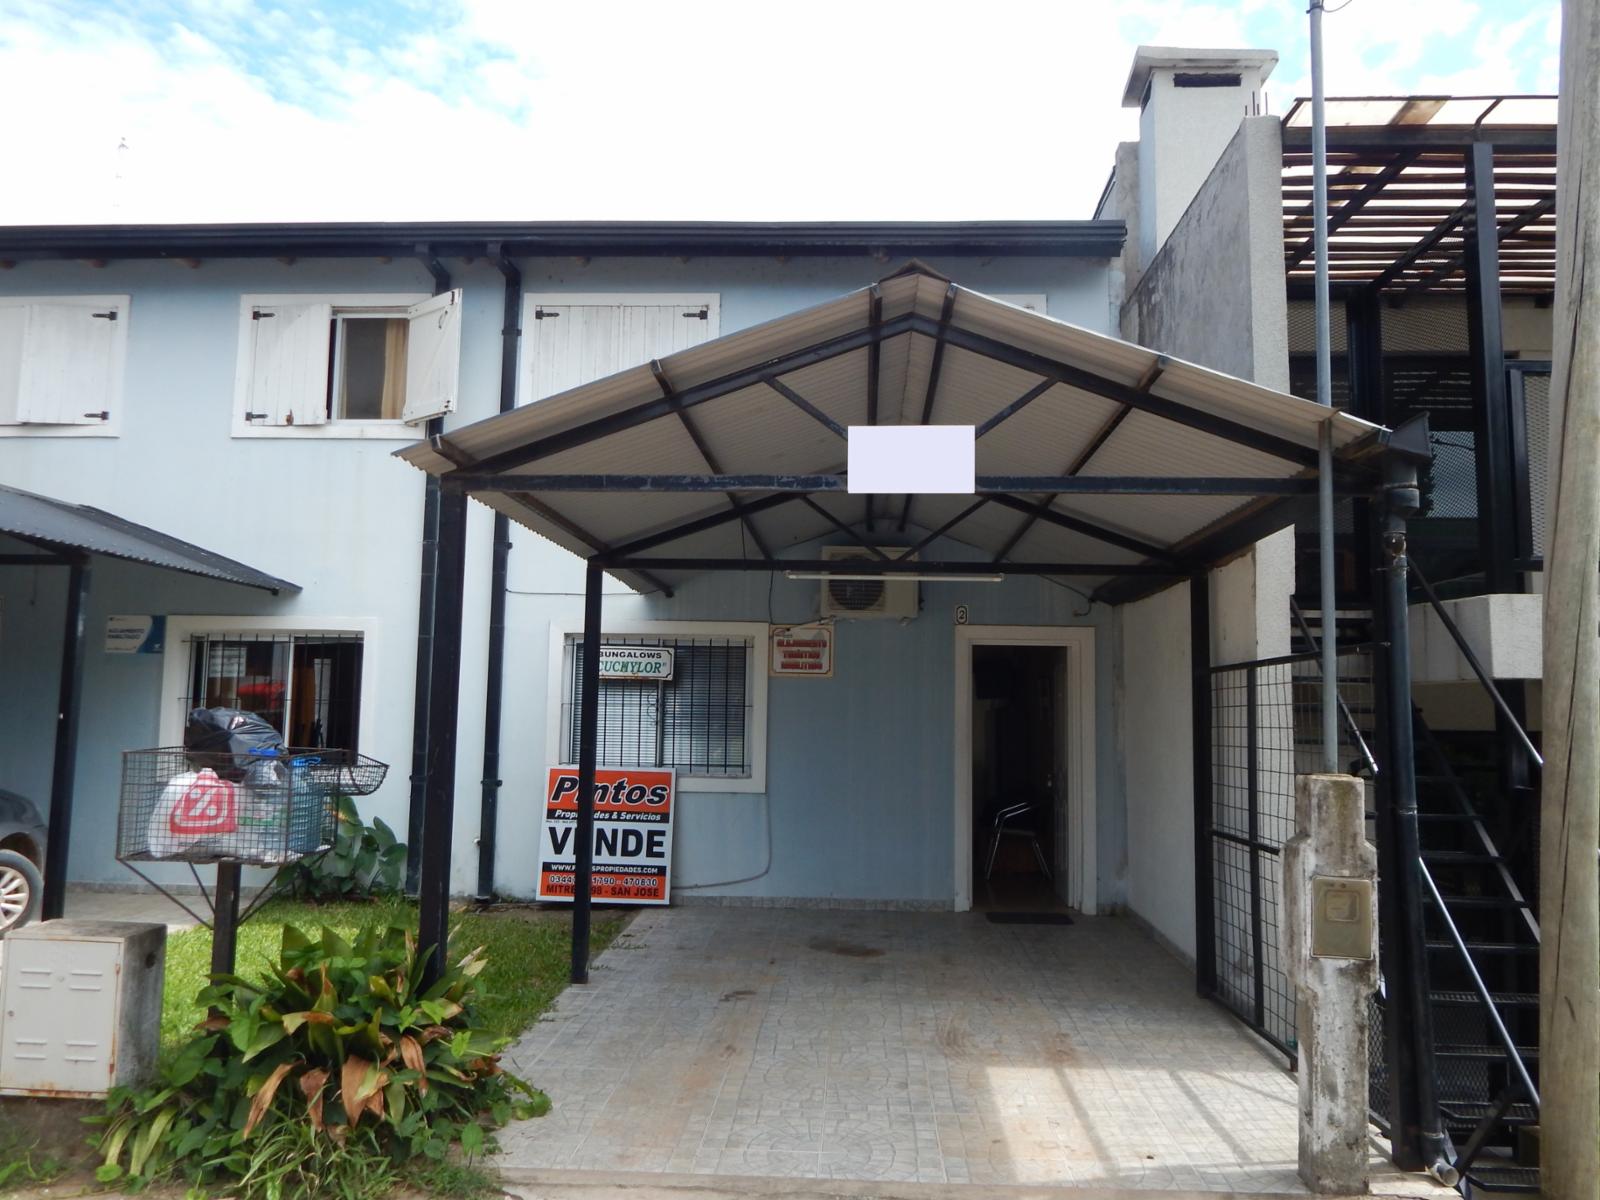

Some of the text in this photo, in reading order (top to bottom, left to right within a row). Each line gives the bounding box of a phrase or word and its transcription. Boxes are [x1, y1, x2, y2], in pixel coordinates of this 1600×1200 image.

[958, 609, 965, 620] 2
[600, 651, 662, 659] BUNGALOWS
[550, 775, 669, 806] Pntos
[620, 812, 661, 820] Servicios
[548, 827, 666, 858] VNDE
[610, 887, 633, 896] SAN
